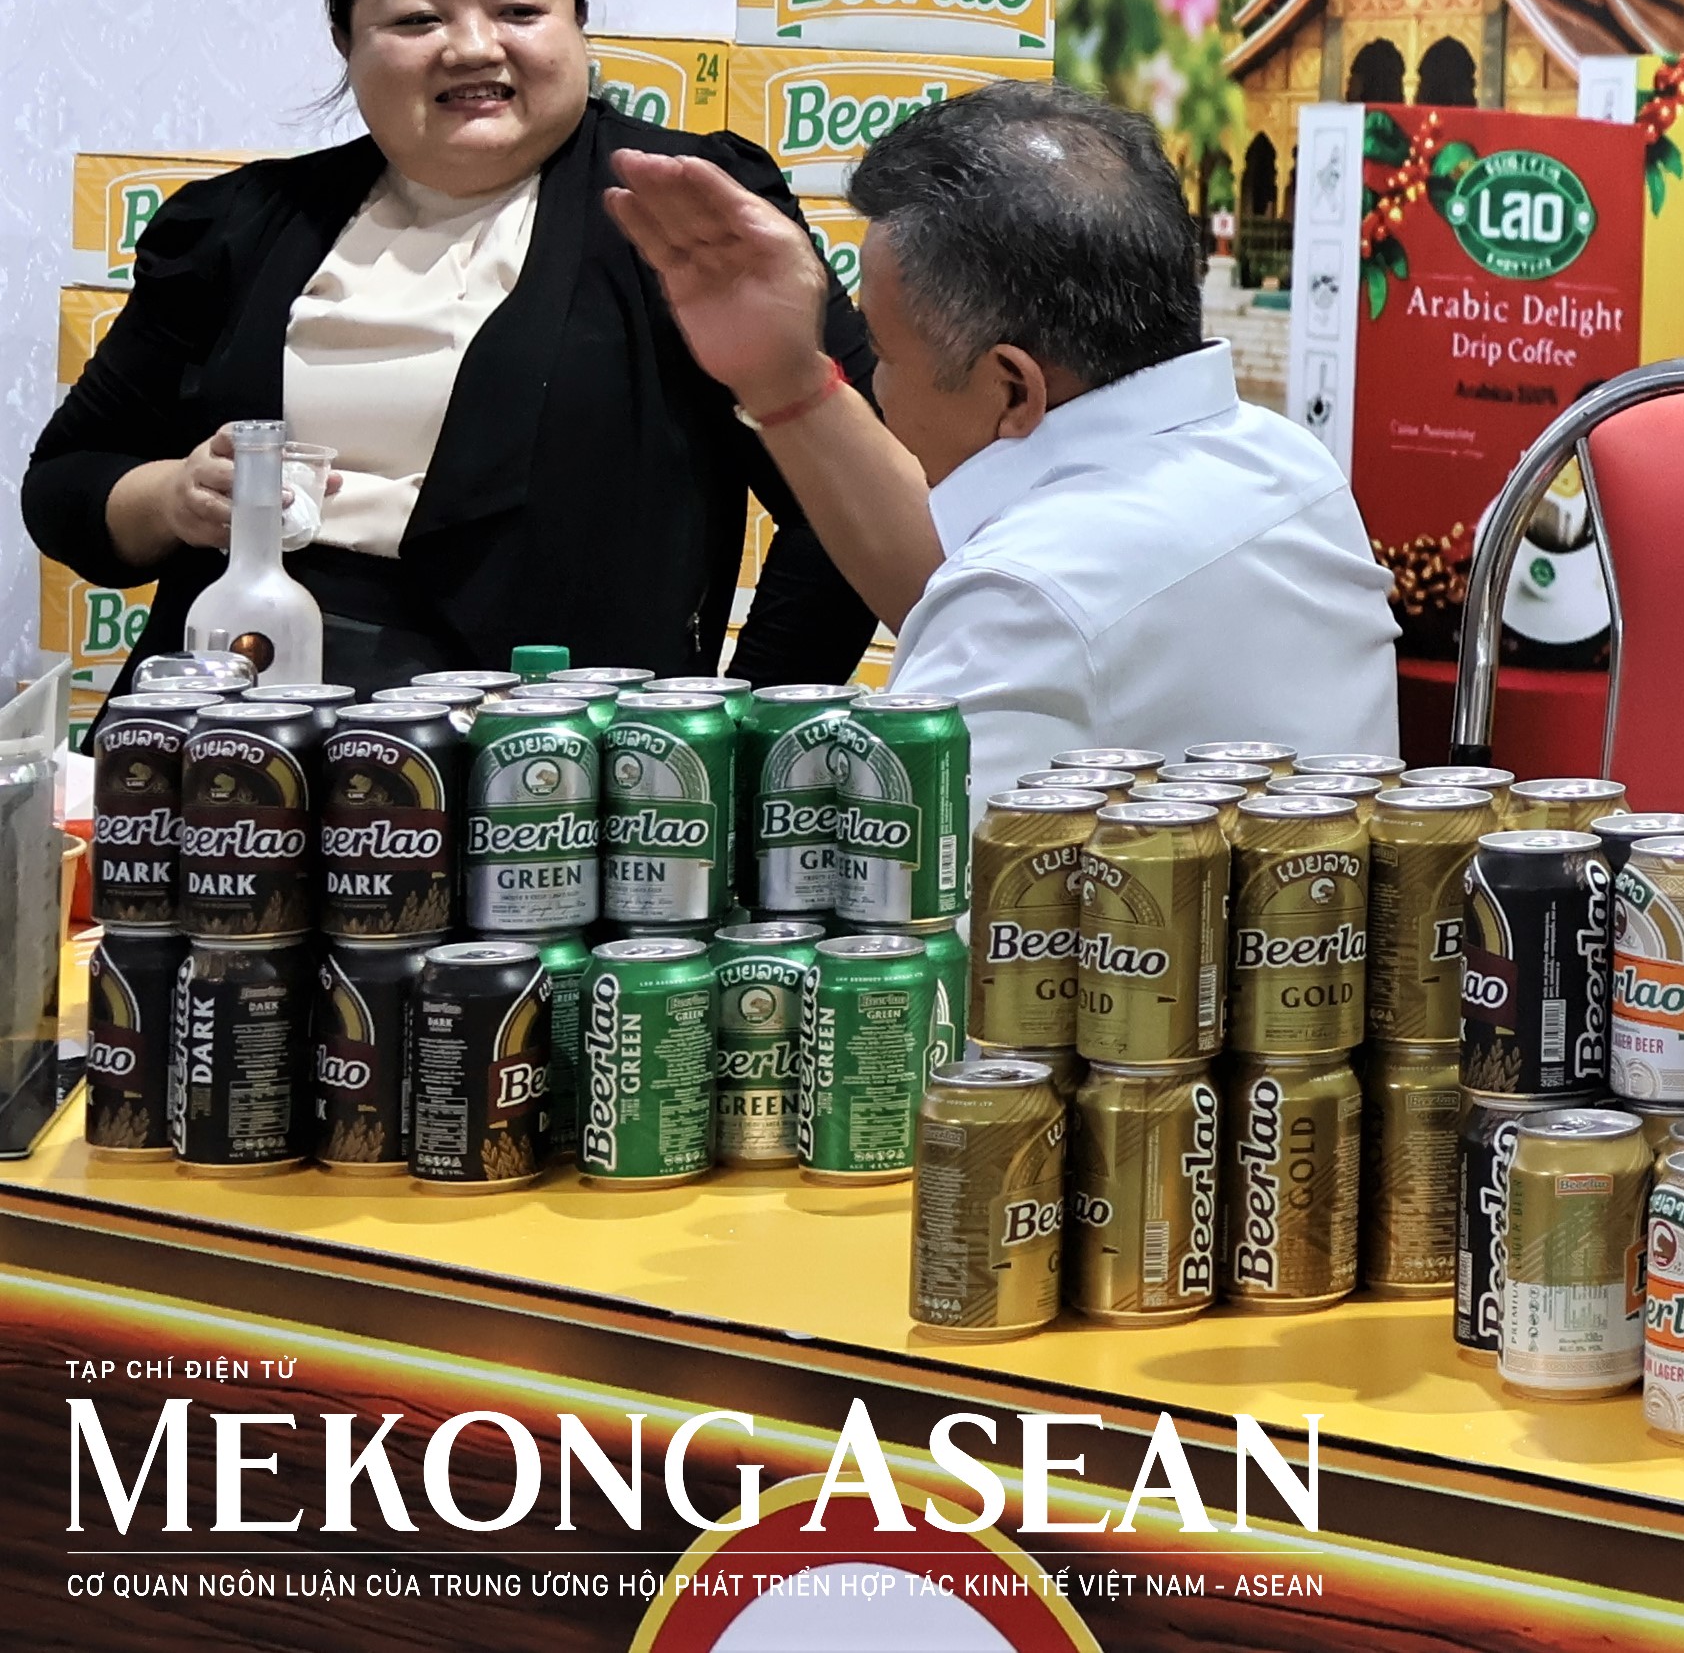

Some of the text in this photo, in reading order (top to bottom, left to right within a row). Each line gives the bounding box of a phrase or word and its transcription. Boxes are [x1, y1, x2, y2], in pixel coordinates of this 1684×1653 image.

[695, 52, 720, 84] 24
[1479, 188, 1565, 244] Lao
[1406, 286, 1625, 338] Arabic Delight
[1452, 333, 1579, 369] Drip Coffee
[102, 859, 172, 884] DARK
[188, 872, 257, 897] DARK
[327, 871, 393, 897] DARK
[497, 865, 582, 890] GREEN
[1236, 923, 1366, 969] Beerla
[1574, 857, 1612, 1079] Beerlao
[1280, 981, 1354, 1009] GOLD
[191, 997, 216, 1085] DARK
[620, 1013, 642, 1094] GREEN
[817, 1007, 836, 1088] GREEN
[1635, 1036, 1665, 1055] BEER
[584, 972, 621, 1172] Beerlao
[1236, 1076, 1284, 1292] Beerlao
[1289, 1116, 1317, 1211] GOLD
[1178, 1083, 1219, 1299] Beerlao
[1654, 1363, 1684, 1385] LAGER
